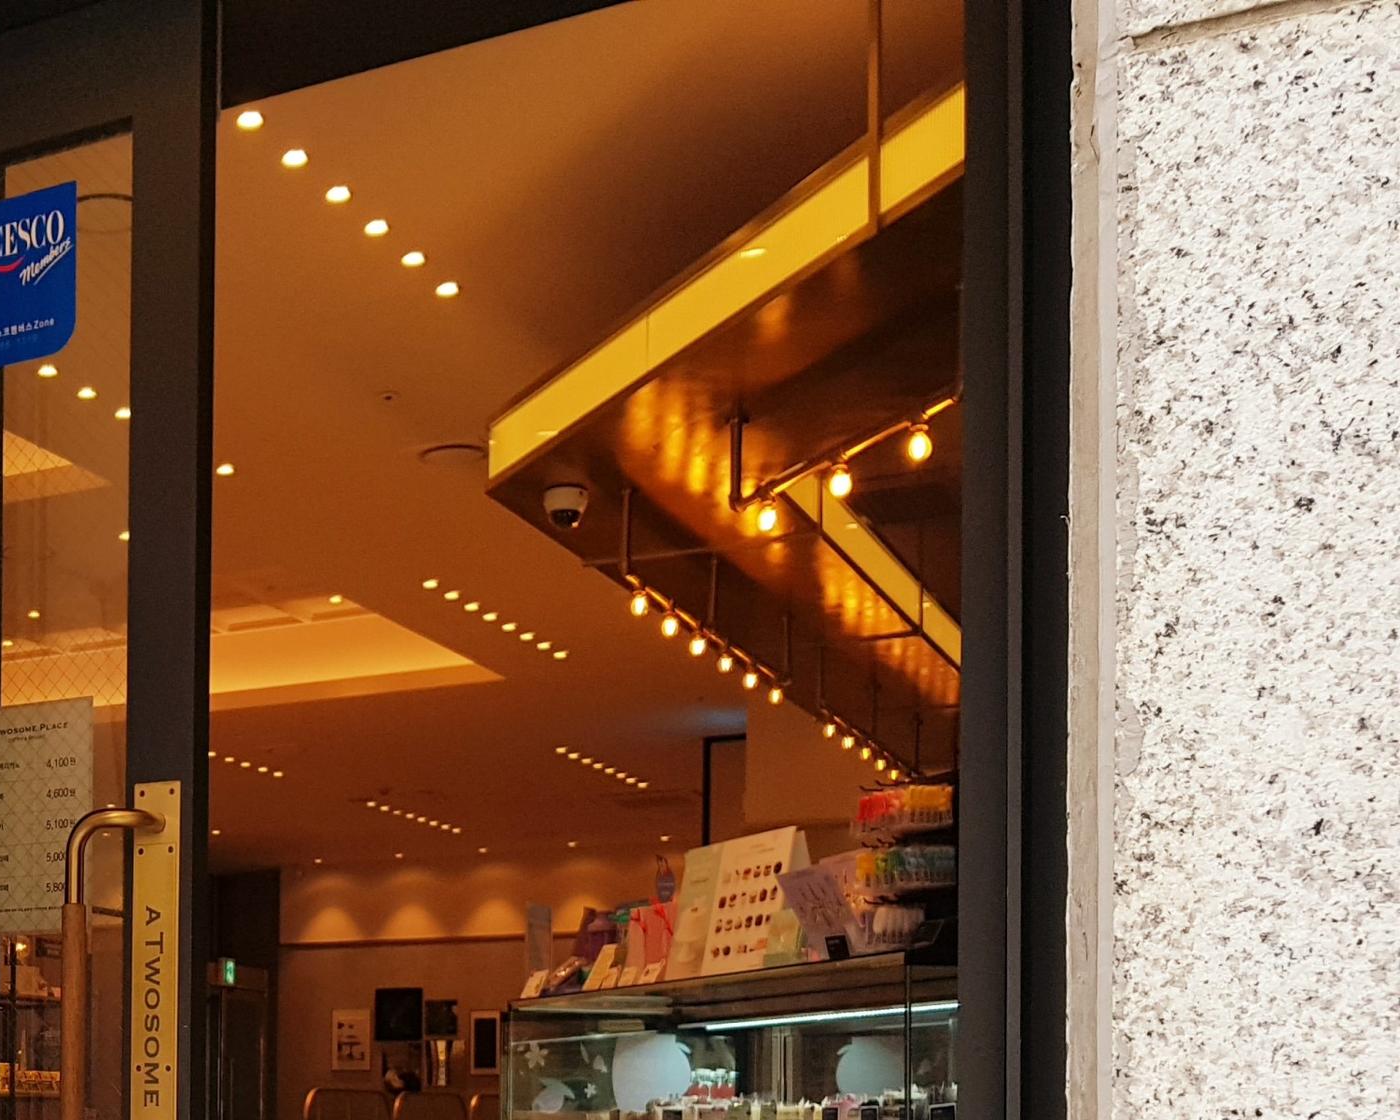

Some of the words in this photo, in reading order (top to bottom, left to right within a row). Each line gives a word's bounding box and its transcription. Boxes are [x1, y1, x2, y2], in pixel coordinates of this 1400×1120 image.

[40, 722, 69, 731] PLACE
[145, 905, 162, 926] A
[143, 931, 165, 1107] TWOSOME
